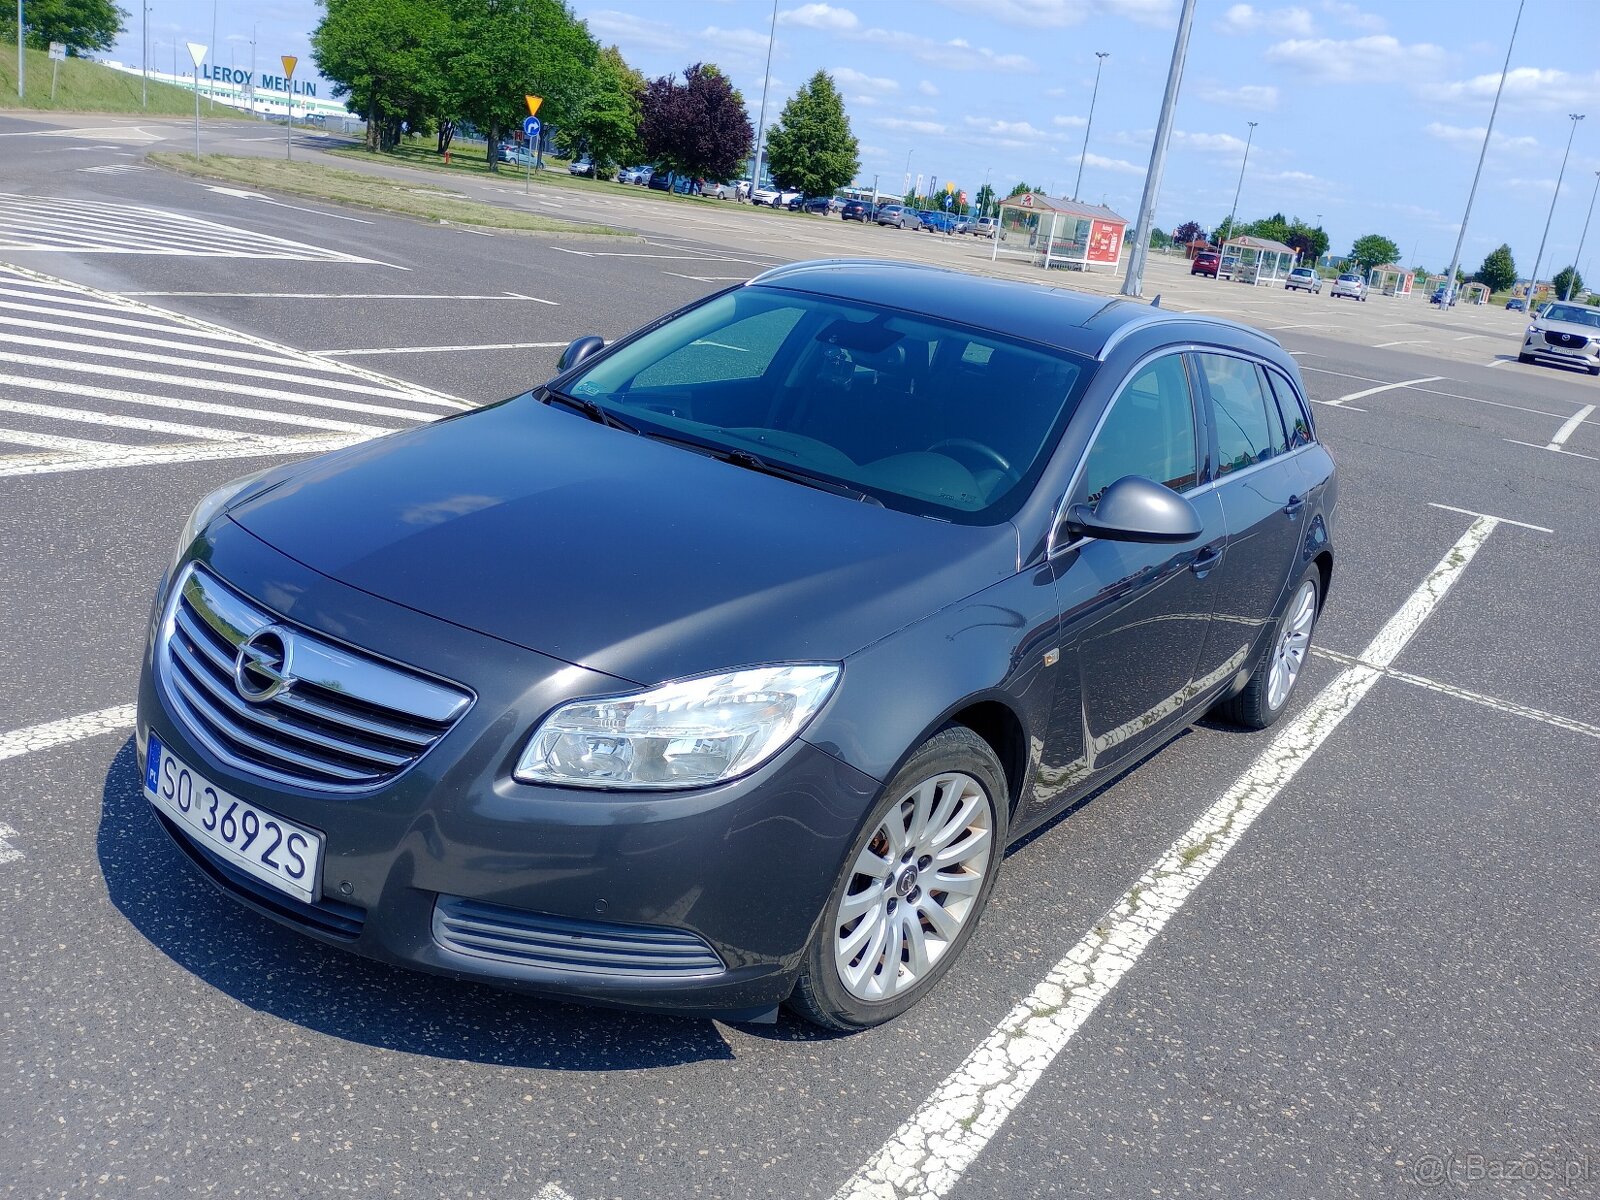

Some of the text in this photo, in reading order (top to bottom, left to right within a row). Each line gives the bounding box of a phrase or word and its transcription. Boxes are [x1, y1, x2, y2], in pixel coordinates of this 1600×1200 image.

[203, 63, 253, 85] LEROY
[149, 767, 157, 785] PL
[162, 756, 309, 879] SO 3692S
